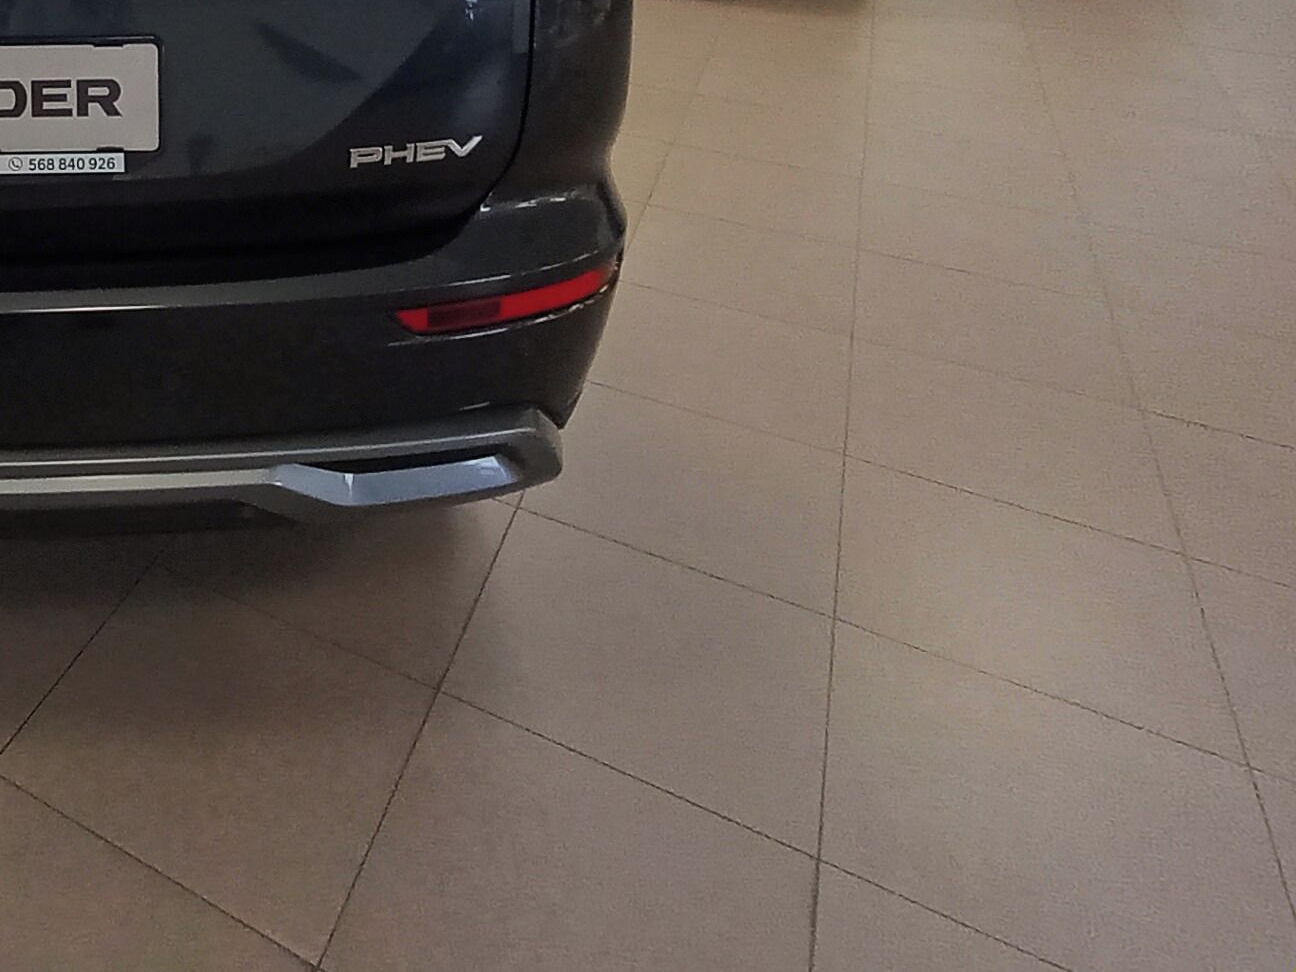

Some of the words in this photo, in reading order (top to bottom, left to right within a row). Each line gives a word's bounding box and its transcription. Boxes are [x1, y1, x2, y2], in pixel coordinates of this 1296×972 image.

[349, 134, 483, 169] PHEV
[28, 157, 55, 171] 568
[58, 157, 85, 171] 840
[88, 157, 116, 170] 926
